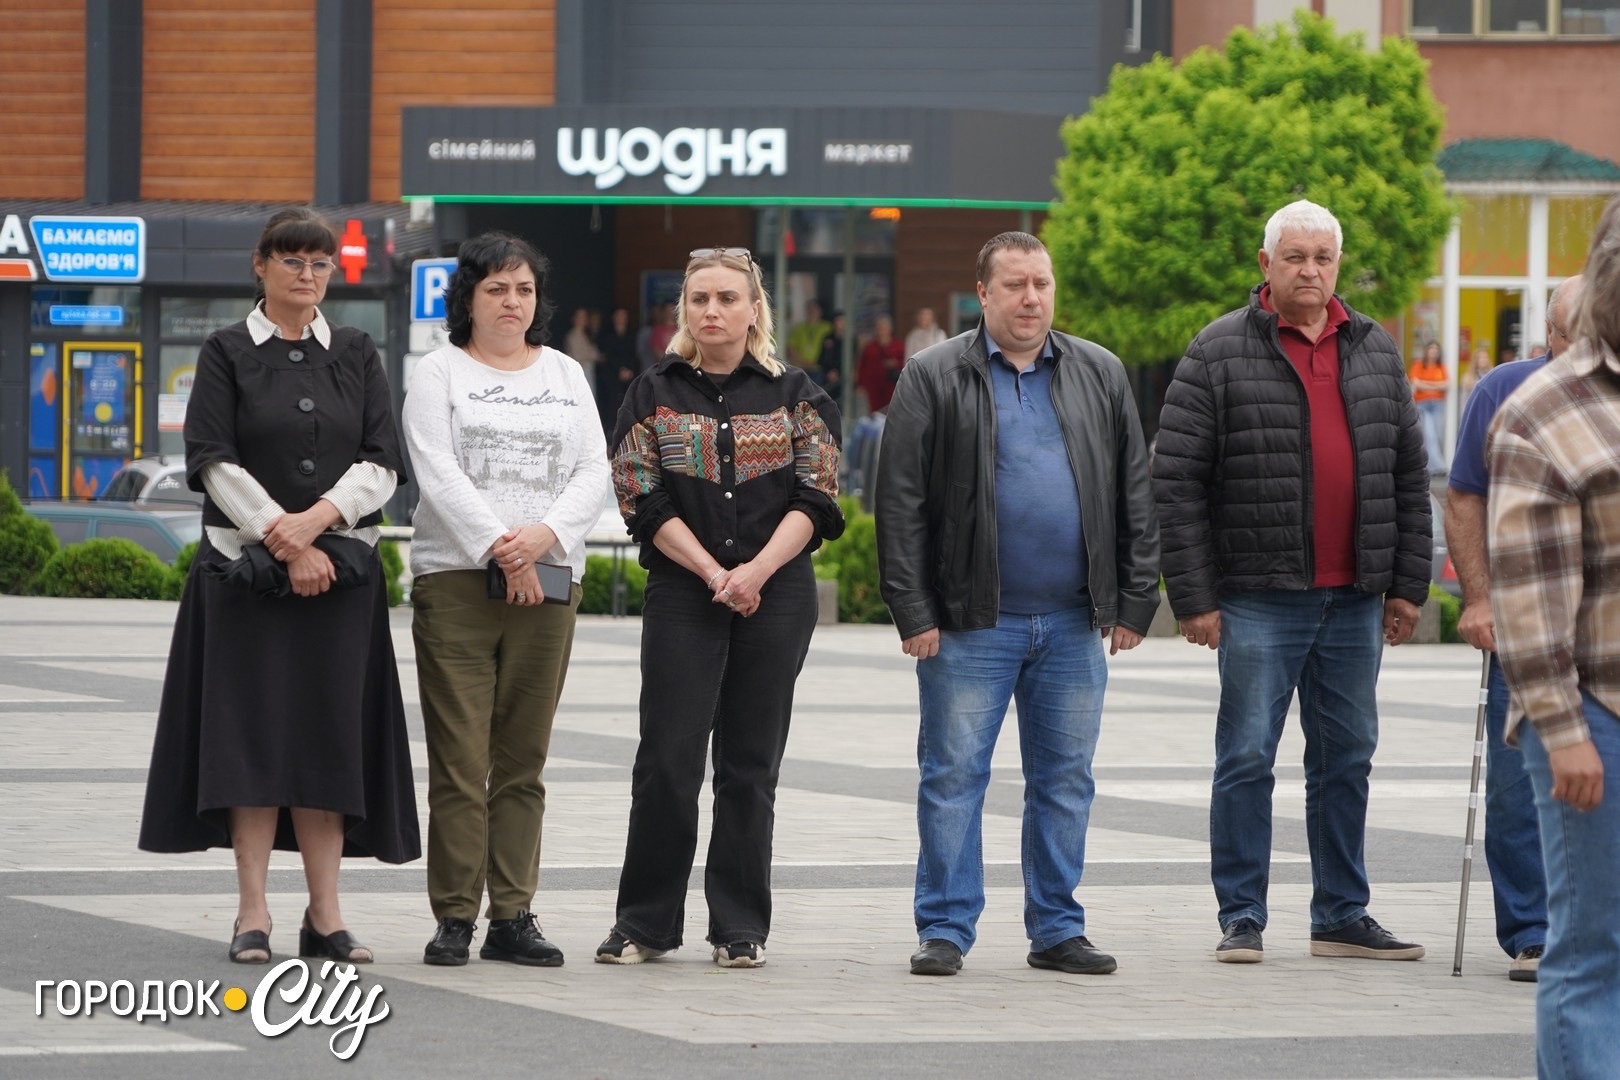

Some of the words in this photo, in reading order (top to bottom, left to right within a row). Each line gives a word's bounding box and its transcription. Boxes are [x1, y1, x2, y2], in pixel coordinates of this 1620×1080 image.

[428, 138, 536, 161] сімейний
[824, 142, 912, 164] маркет
[42, 228, 136, 246] БАЖАЄМО
[48, 252, 136, 272] ЗДОРОВ'Я
[468, 385, 578, 406] London
[484, 452, 542, 465] adventure
